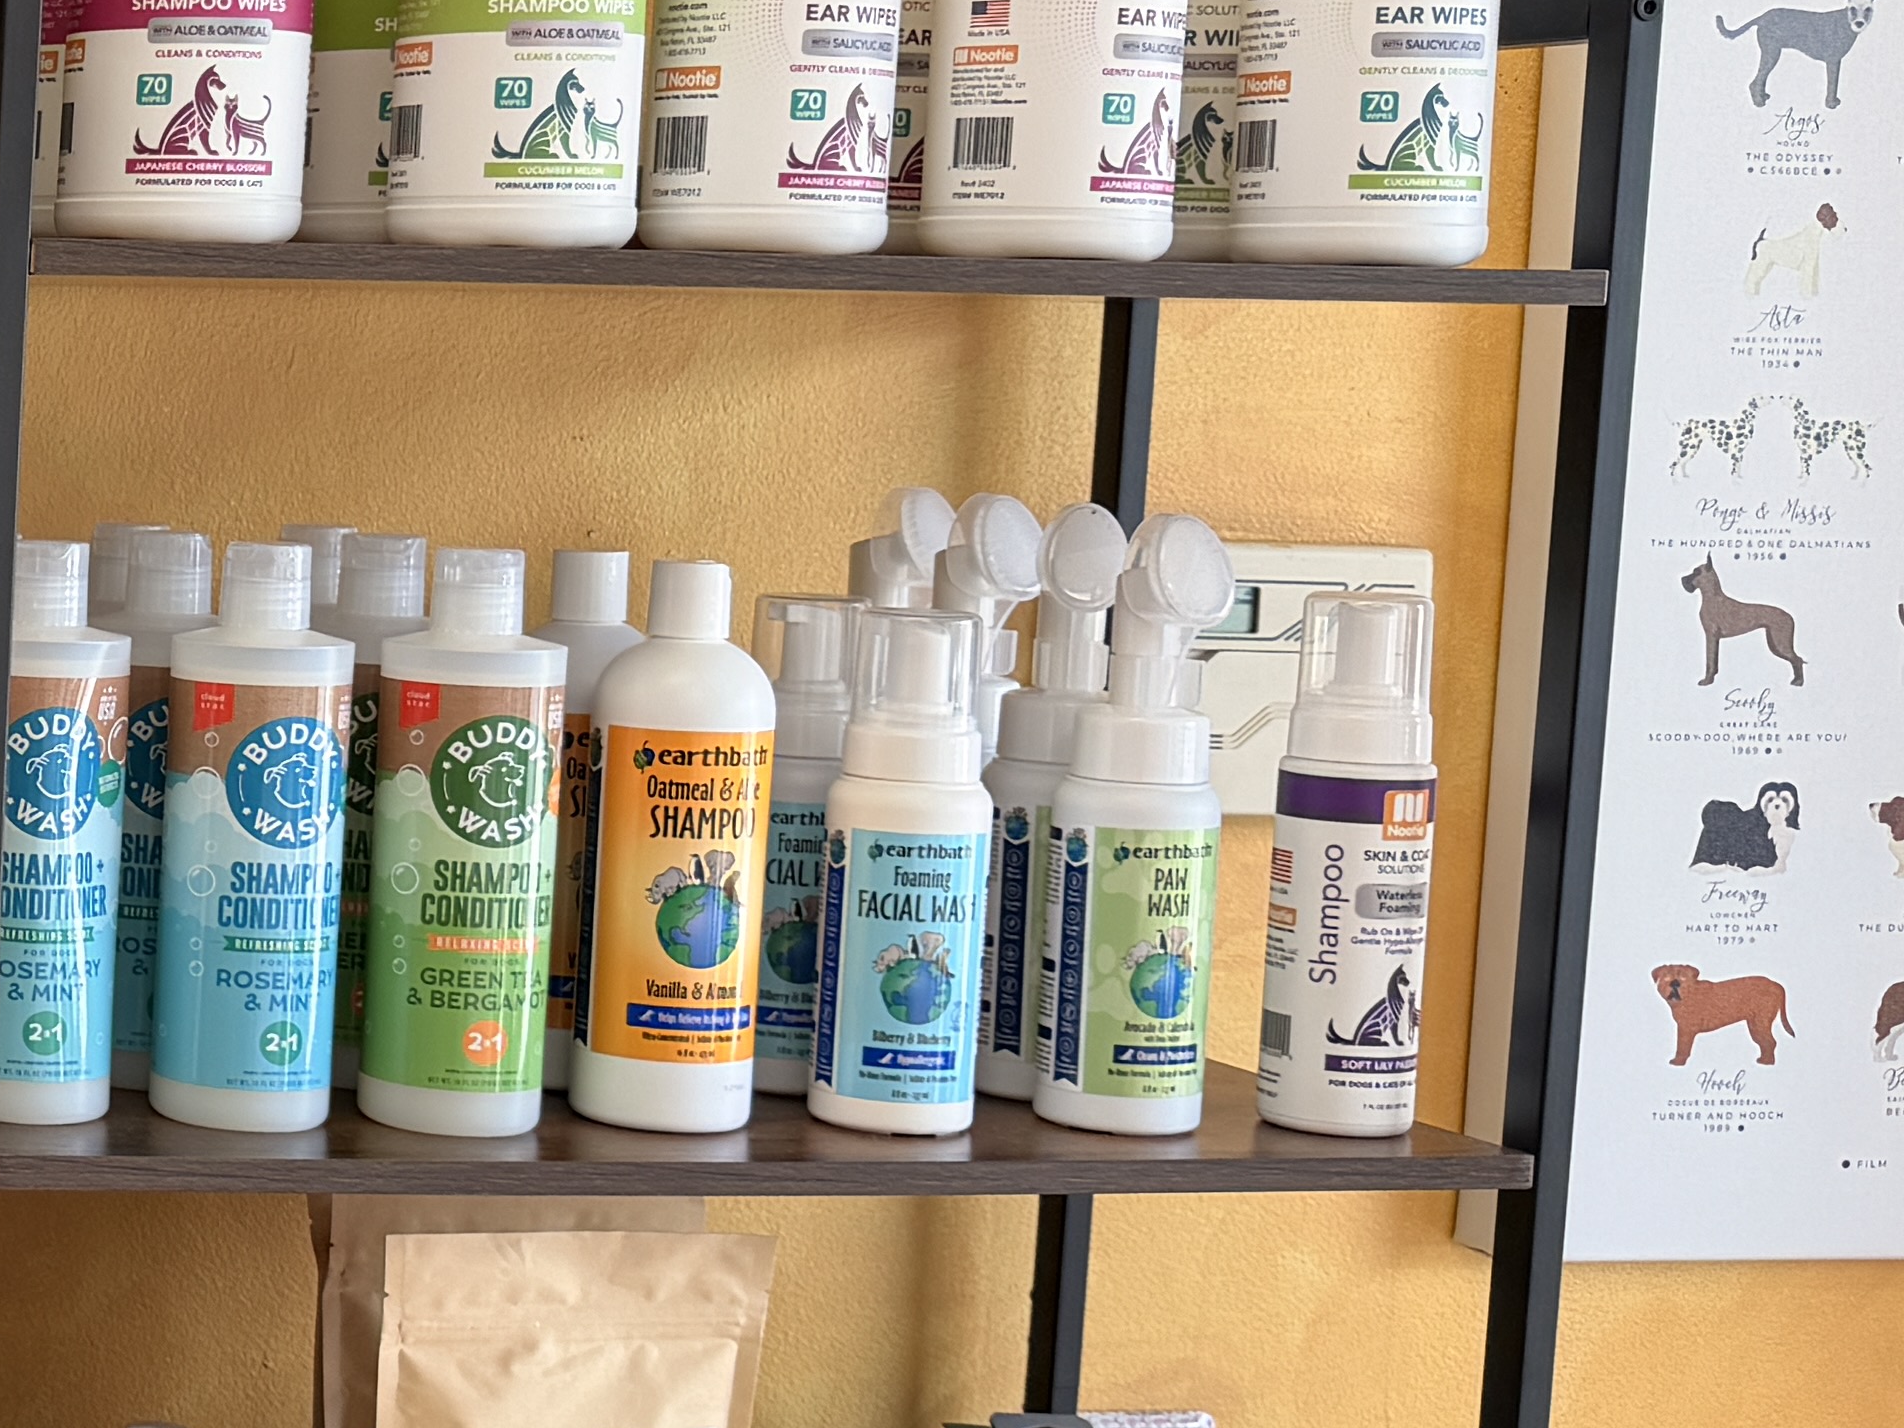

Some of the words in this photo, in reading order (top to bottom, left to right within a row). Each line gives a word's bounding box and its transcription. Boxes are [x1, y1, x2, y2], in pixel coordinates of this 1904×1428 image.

[1375, 5, 1426, 26] EAR
[1432, 5, 1487, 27] WIPES
[142, 76, 167, 96] 70
[133, 163, 182, 172] JAPANESE
[185, 163, 223, 173] CHERRY
[1746, 153, 1770, 161] THE
[1776, 154, 1834, 162] ODYSSEY
[1731, 347, 1755, 357] THE
[1761, 348, 1789, 357] THIN
[1795, 348, 1824, 357] MAN
[447, 721, 547, 769] BUDDY
[658, 745, 768, 767] earthbath
[647, 774, 714, 801] Oatmeal
[719, 777, 734, 801] &
[736, 778, 760, 800] Ale
[456, 802, 544, 843] WASH
[893, 867, 951, 892] Foaming
[1154, 868, 1187, 890] PAW
[857, 893, 926, 920] FACIAL
[1308, 843, 1344, 985] Shampoo
[1686, 923, 1719, 932] HART
[1724, 924, 1739, 932] TO
[1745, 924, 1779, 933] HART
[420, 967, 503, 990] GREEN
[1652, 1111, 1703, 1120] TURNER
[1708, 1111, 1733, 1120] AND
[1738, 1110, 1784, 1120] HOOCH
[1857, 1159, 1888, 1168] FILM
